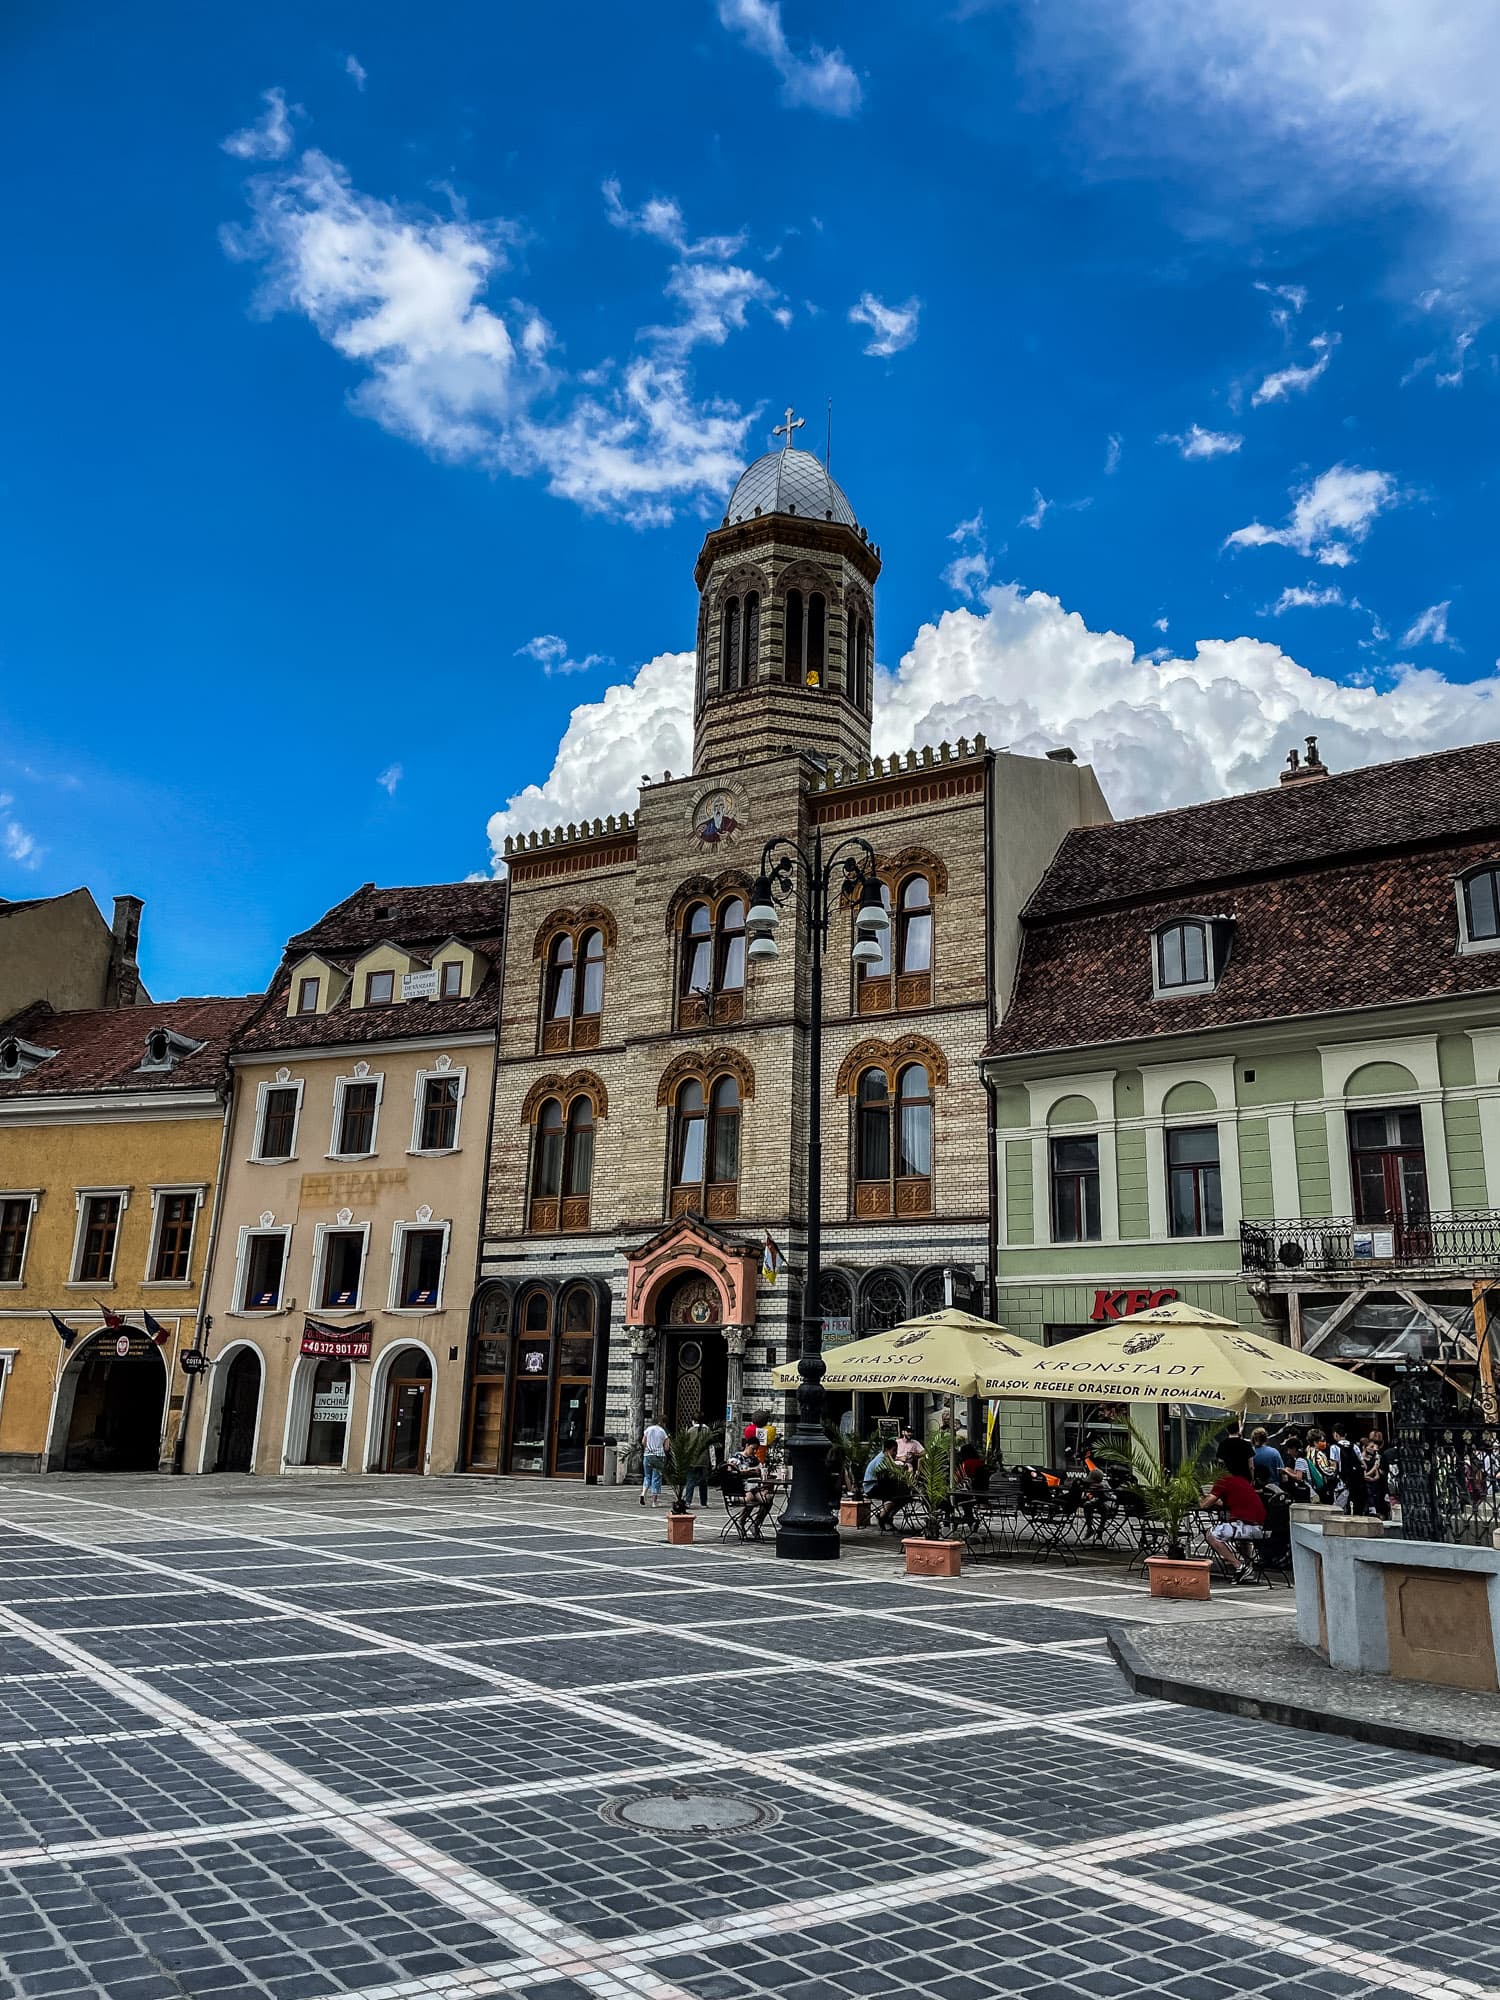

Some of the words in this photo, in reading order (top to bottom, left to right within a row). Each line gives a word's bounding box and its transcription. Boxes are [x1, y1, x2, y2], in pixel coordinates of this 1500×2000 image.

[1090, 1288, 1177, 1320] KFC
[303, 1341, 319, 1352] +40
[320, 1343, 334, 1353] 372
[335, 1344, 351, 1354] 901
[353, 1344, 368, 1354] 770
[842, 1353, 925, 1365] BRASSÓ
[1033, 1360, 1205, 1376] KRONSTADT
[822, 1374, 847, 1383] EGELE
[850, 1374, 897, 1385] ORAȘELOR
[334, 1386, 345, 1394] DE
[985, 1379, 1029, 1390] BRAȘOV.
[1033, 1381, 1075, 1392] REGELE
[1078, 1383, 1140, 1396] ORAȘELOR
[1144, 1384, 1158, 1396] ÎN
[1162, 1387, 1226, 1400] ROMÂNIA.
[1288, 1393, 1312, 1405] REGELE
